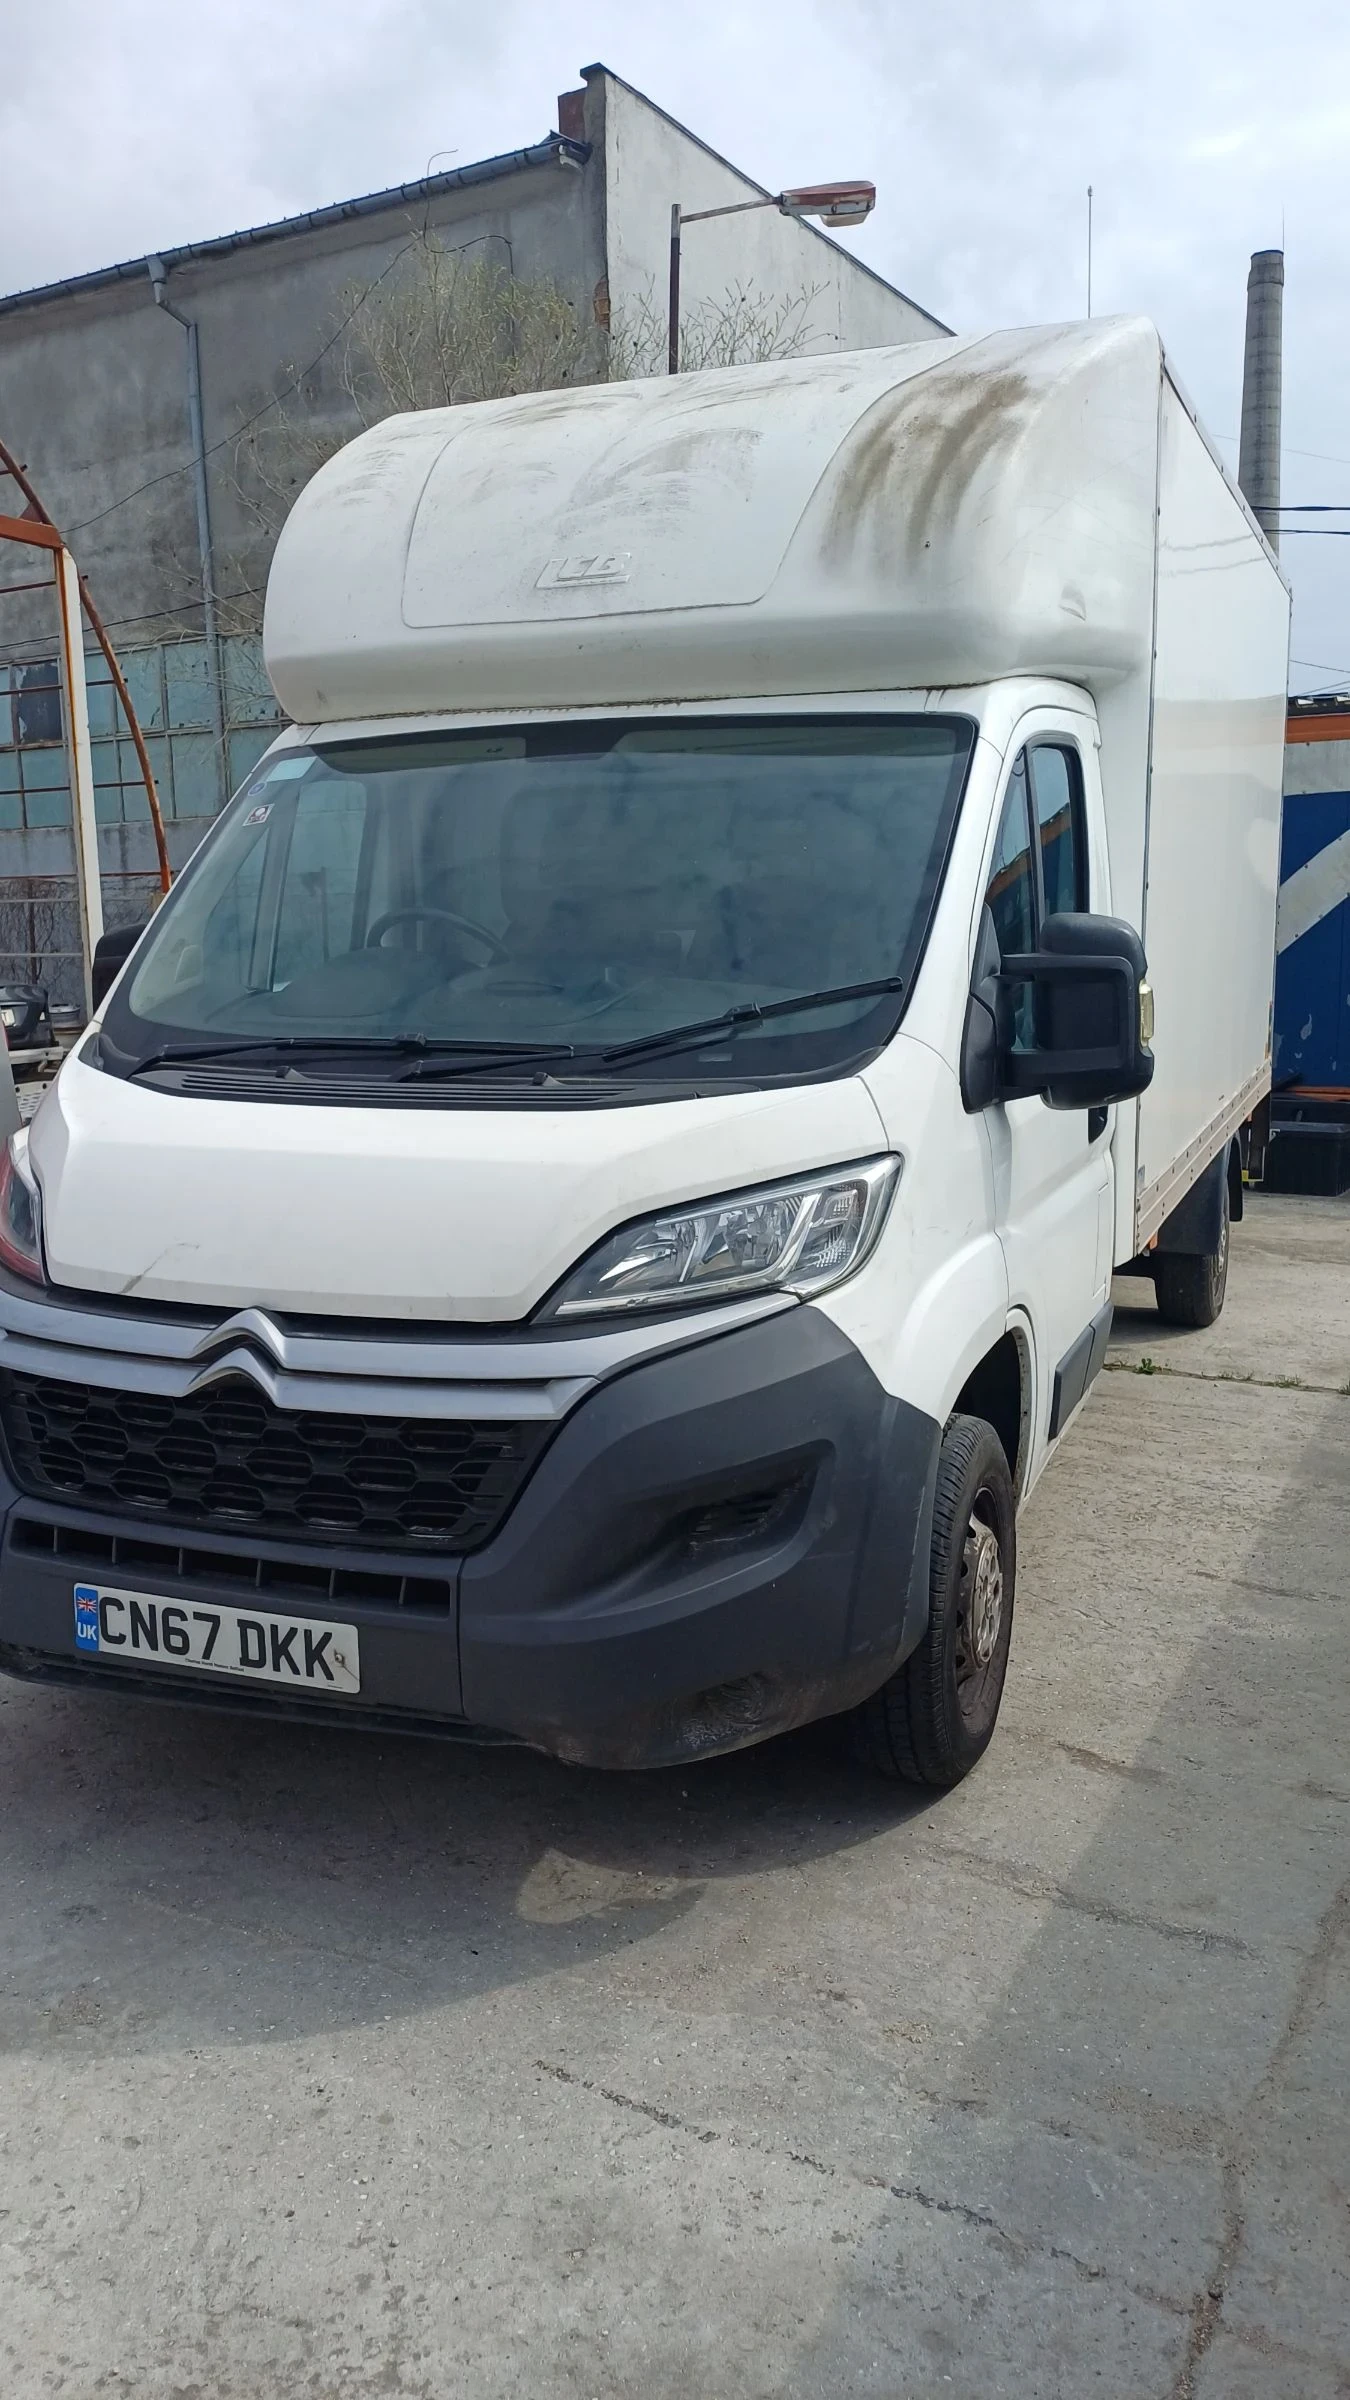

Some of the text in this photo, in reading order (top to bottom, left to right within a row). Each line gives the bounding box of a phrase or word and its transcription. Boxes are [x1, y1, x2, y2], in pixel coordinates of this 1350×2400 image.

[77, 1621, 98, 1641] UK
[99, 1596, 335, 1681] CN67 DKK
